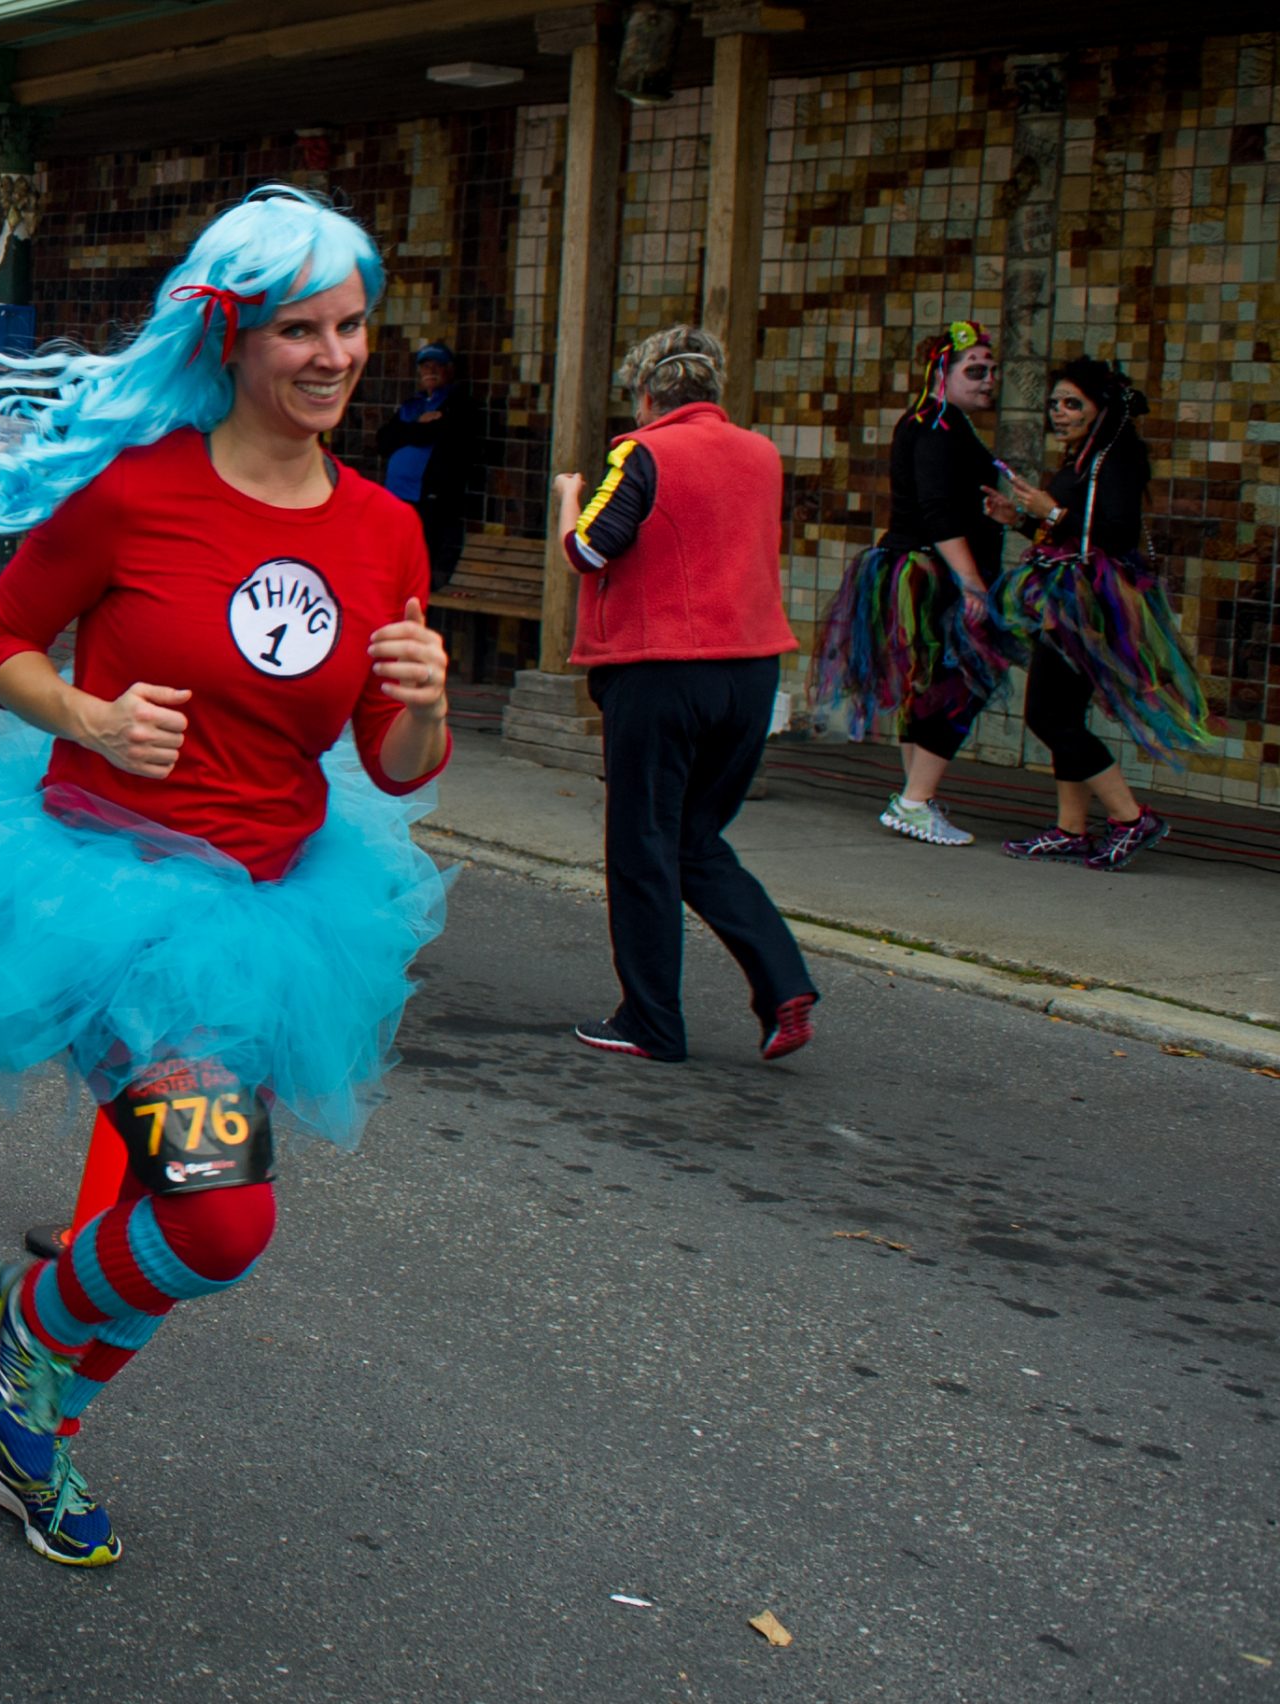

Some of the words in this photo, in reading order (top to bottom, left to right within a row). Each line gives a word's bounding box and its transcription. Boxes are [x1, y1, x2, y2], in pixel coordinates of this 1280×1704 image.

[240, 575, 332, 635] THING
[260, 623, 288, 667] 1
[133, 1093, 250, 1157] 776
